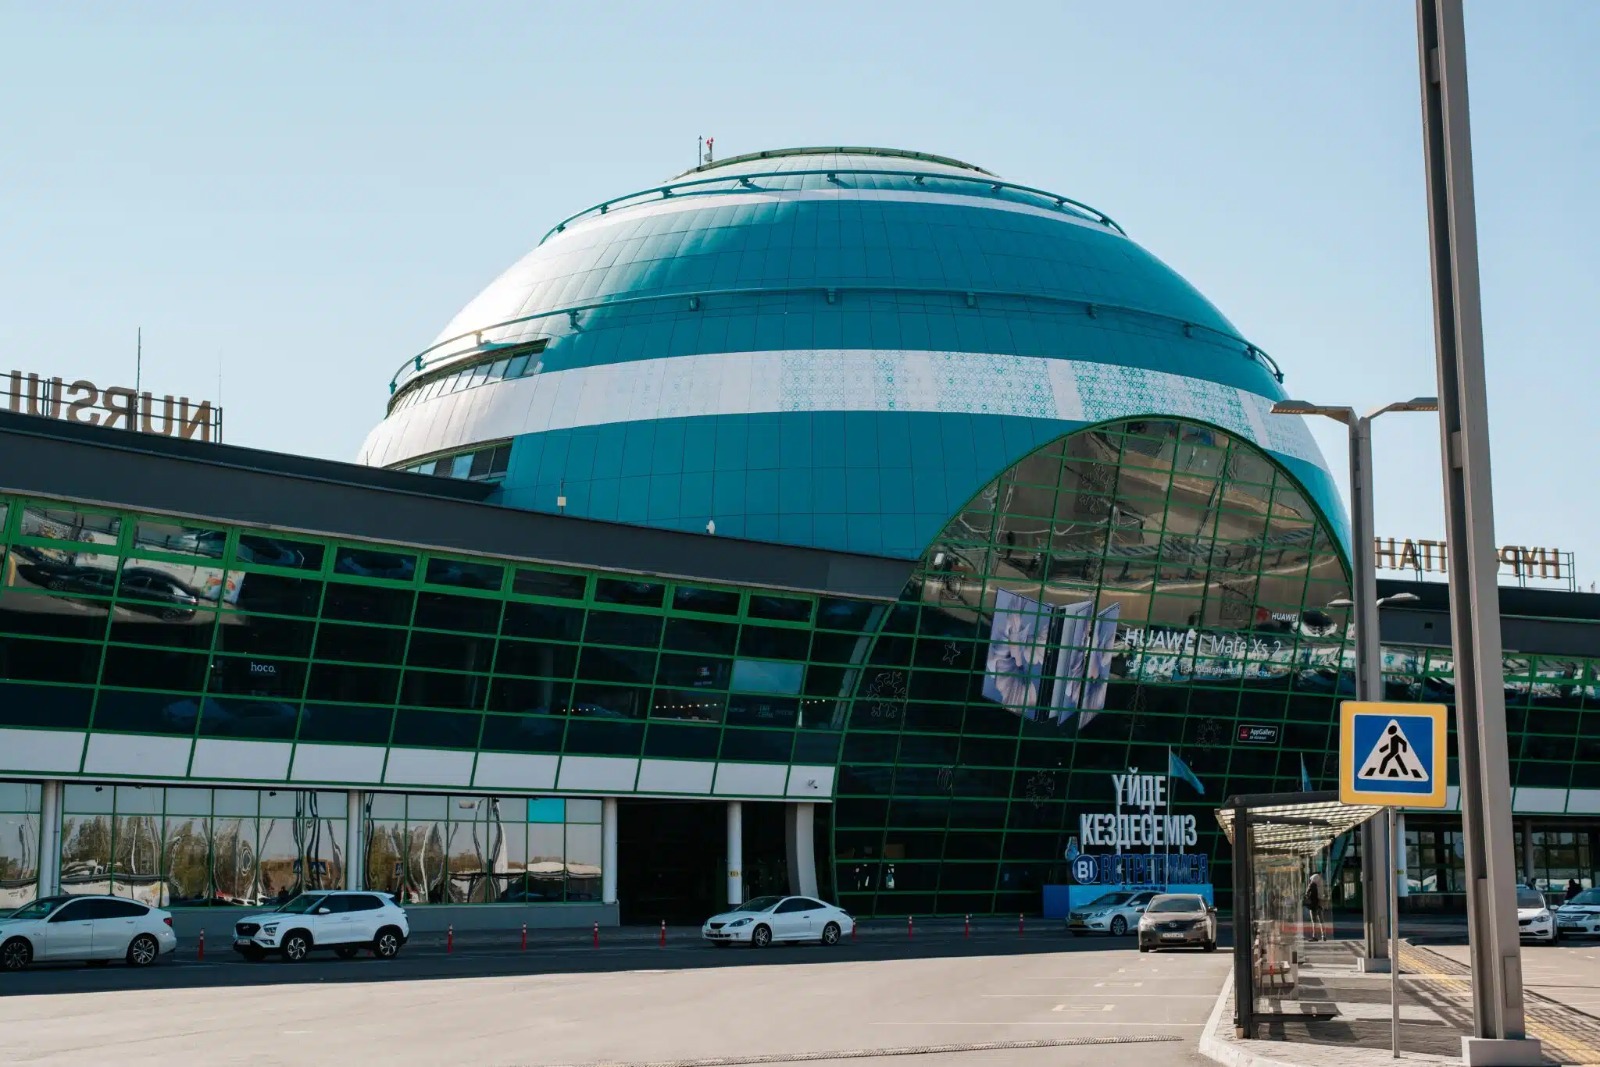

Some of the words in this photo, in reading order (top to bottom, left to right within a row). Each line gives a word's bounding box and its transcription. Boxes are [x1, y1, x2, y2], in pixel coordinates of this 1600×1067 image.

[1271, 612, 1299, 622] HUAWEI
[1124, 627, 1198, 651] HUAWE
[1210, 634, 1247, 654] Mate
[1252, 638, 1268, 657] Xs
[1271, 640, 1282, 657] 2
[1250, 728, 1276, 737] AppGallery
[1112, 767, 1167, 810] ҮЙДЕ
[1080, 813, 1198, 850] КЕЗДЕСЕМІЗ
